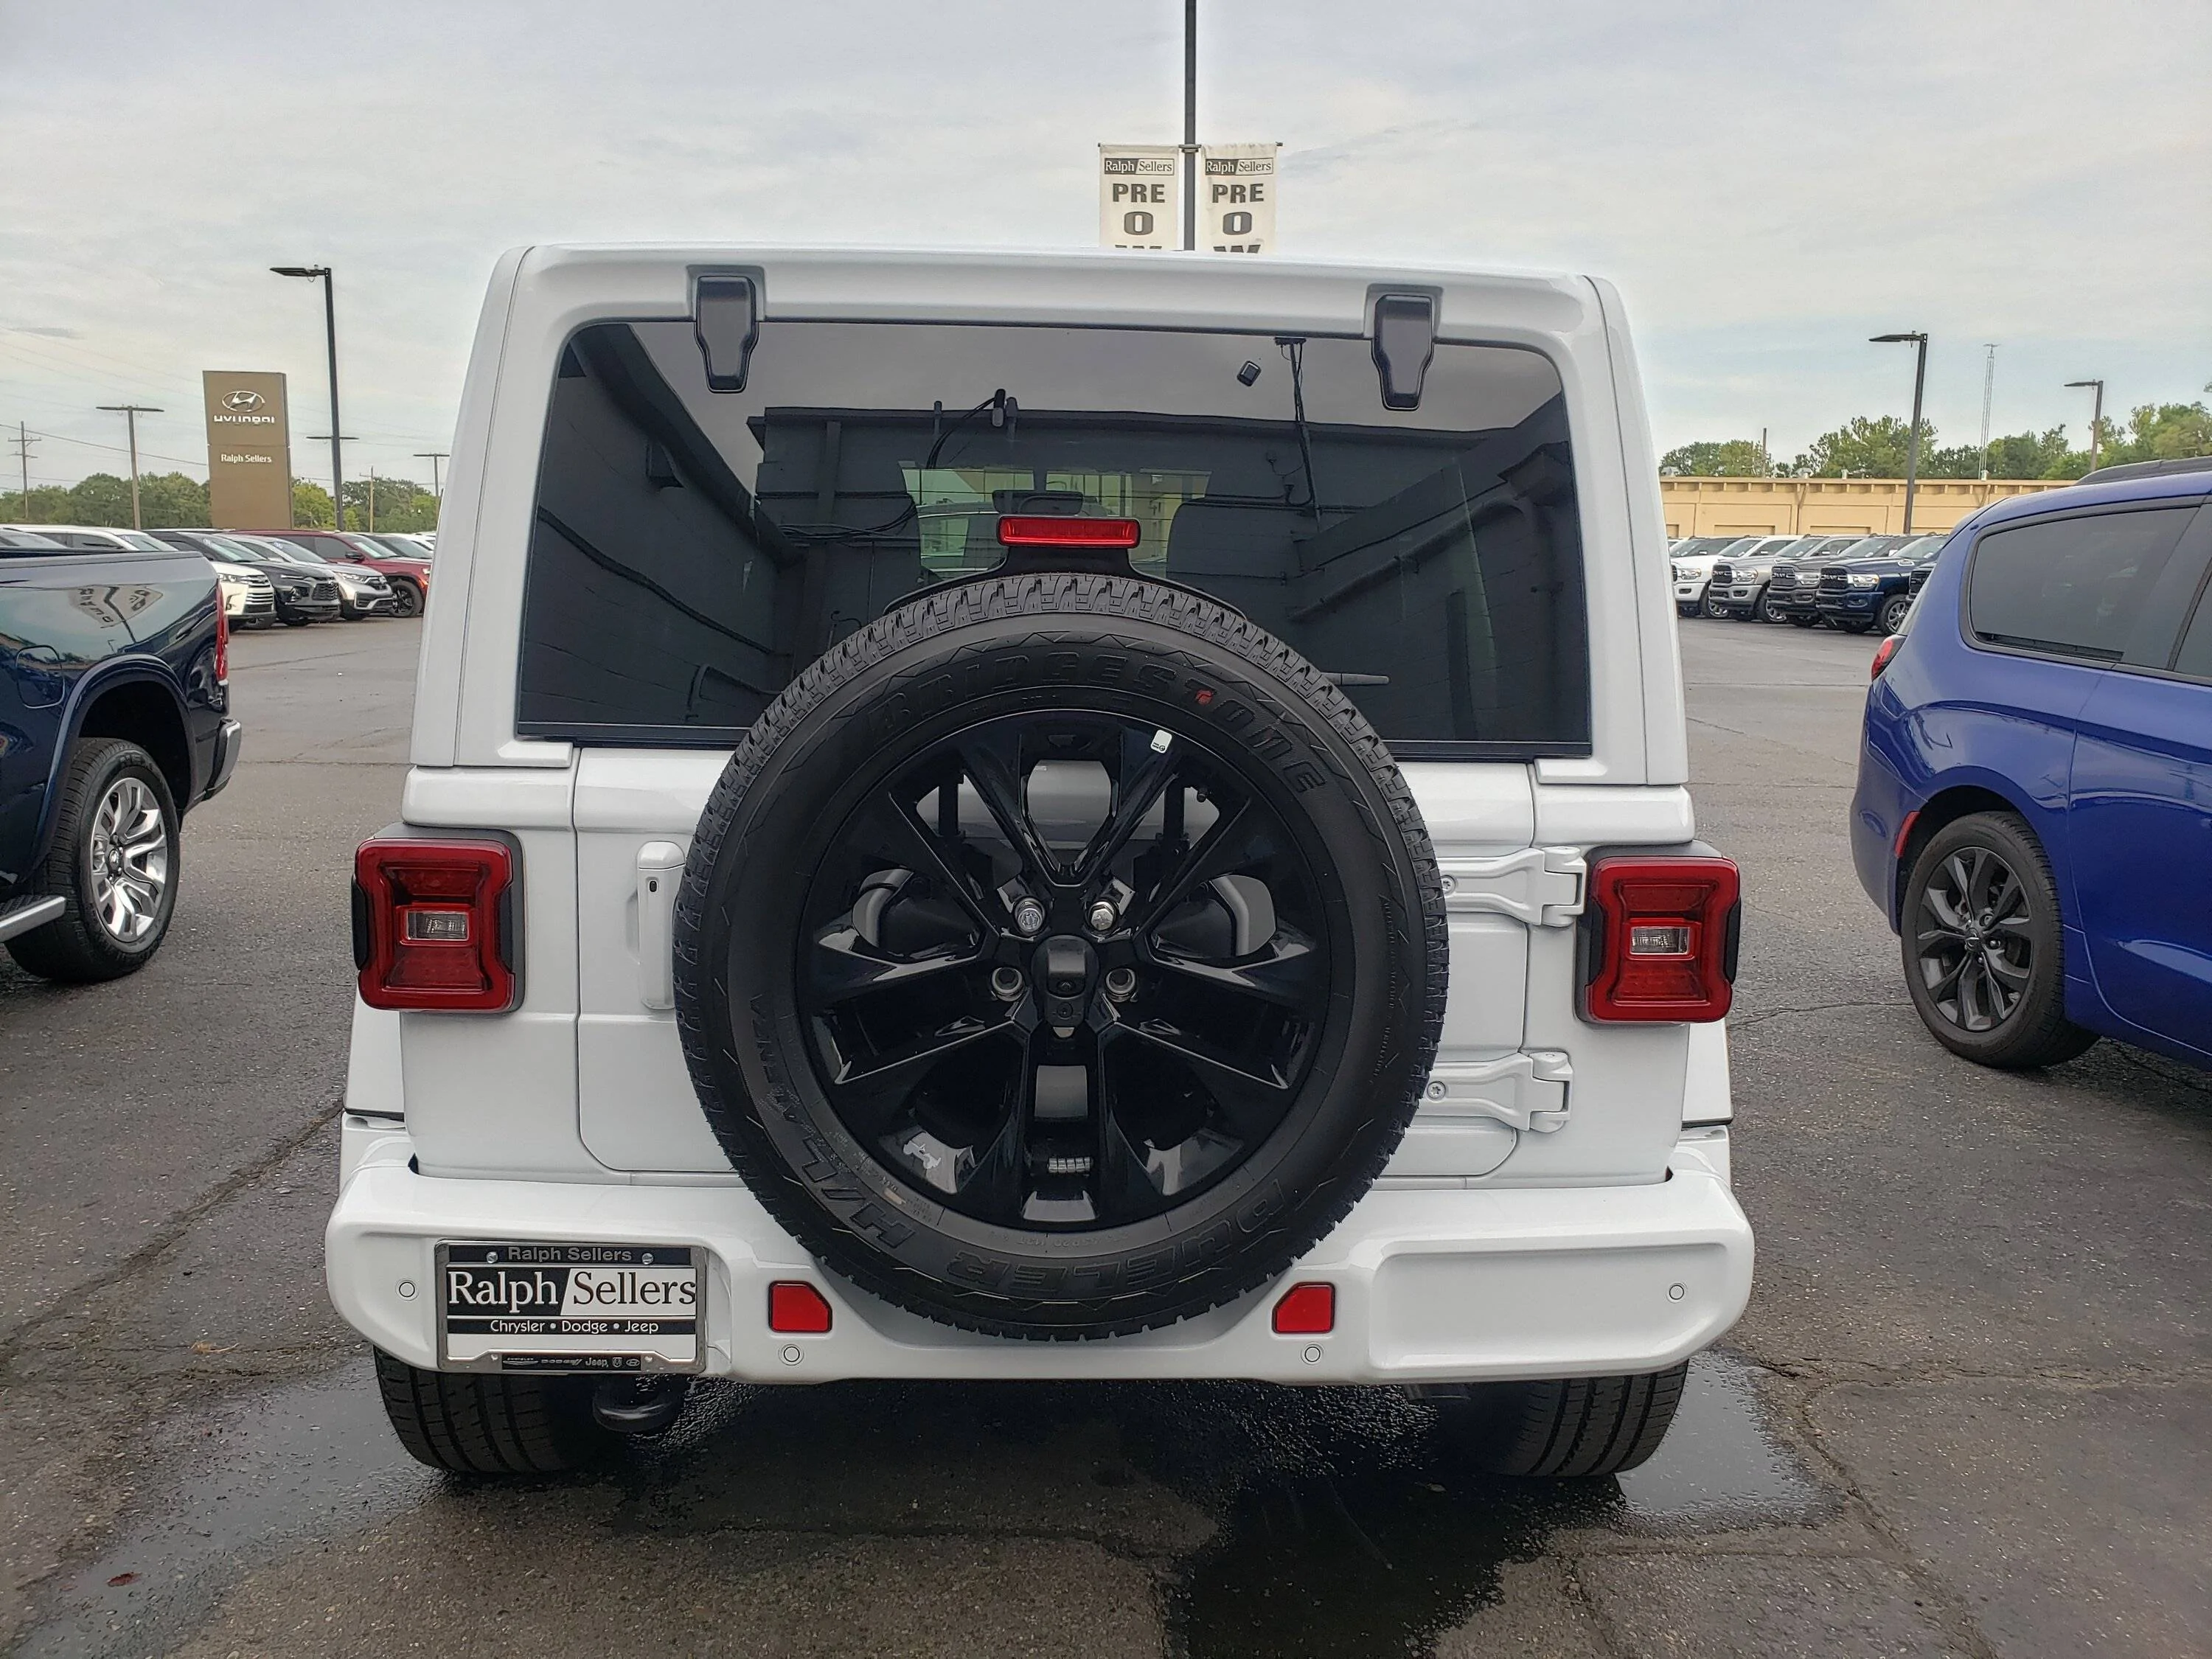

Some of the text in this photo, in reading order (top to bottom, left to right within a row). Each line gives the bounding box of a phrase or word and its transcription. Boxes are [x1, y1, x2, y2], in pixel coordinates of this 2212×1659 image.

[1105, 159, 1172, 173] Ralph Sellers
[1206, 160, 1271, 173] Ralph Sellers
[1113, 183, 1165, 203] PRE
[1212, 183, 1264, 203] PRE
[1124, 211, 1153, 235] O
[1222, 211, 1252, 235] O
[221, 453, 272, 463] Ralph Sellers
[867, 650, 1326, 793] BRIDGESTONE
[944, 1179, 1287, 1293] DUELER
[508, 1247, 632, 1262] Ralph Sellers
[448, 1270, 696, 1313] Ralph Sellers
[490, 1320, 658, 1334] Chrysler Dodge Jeep
